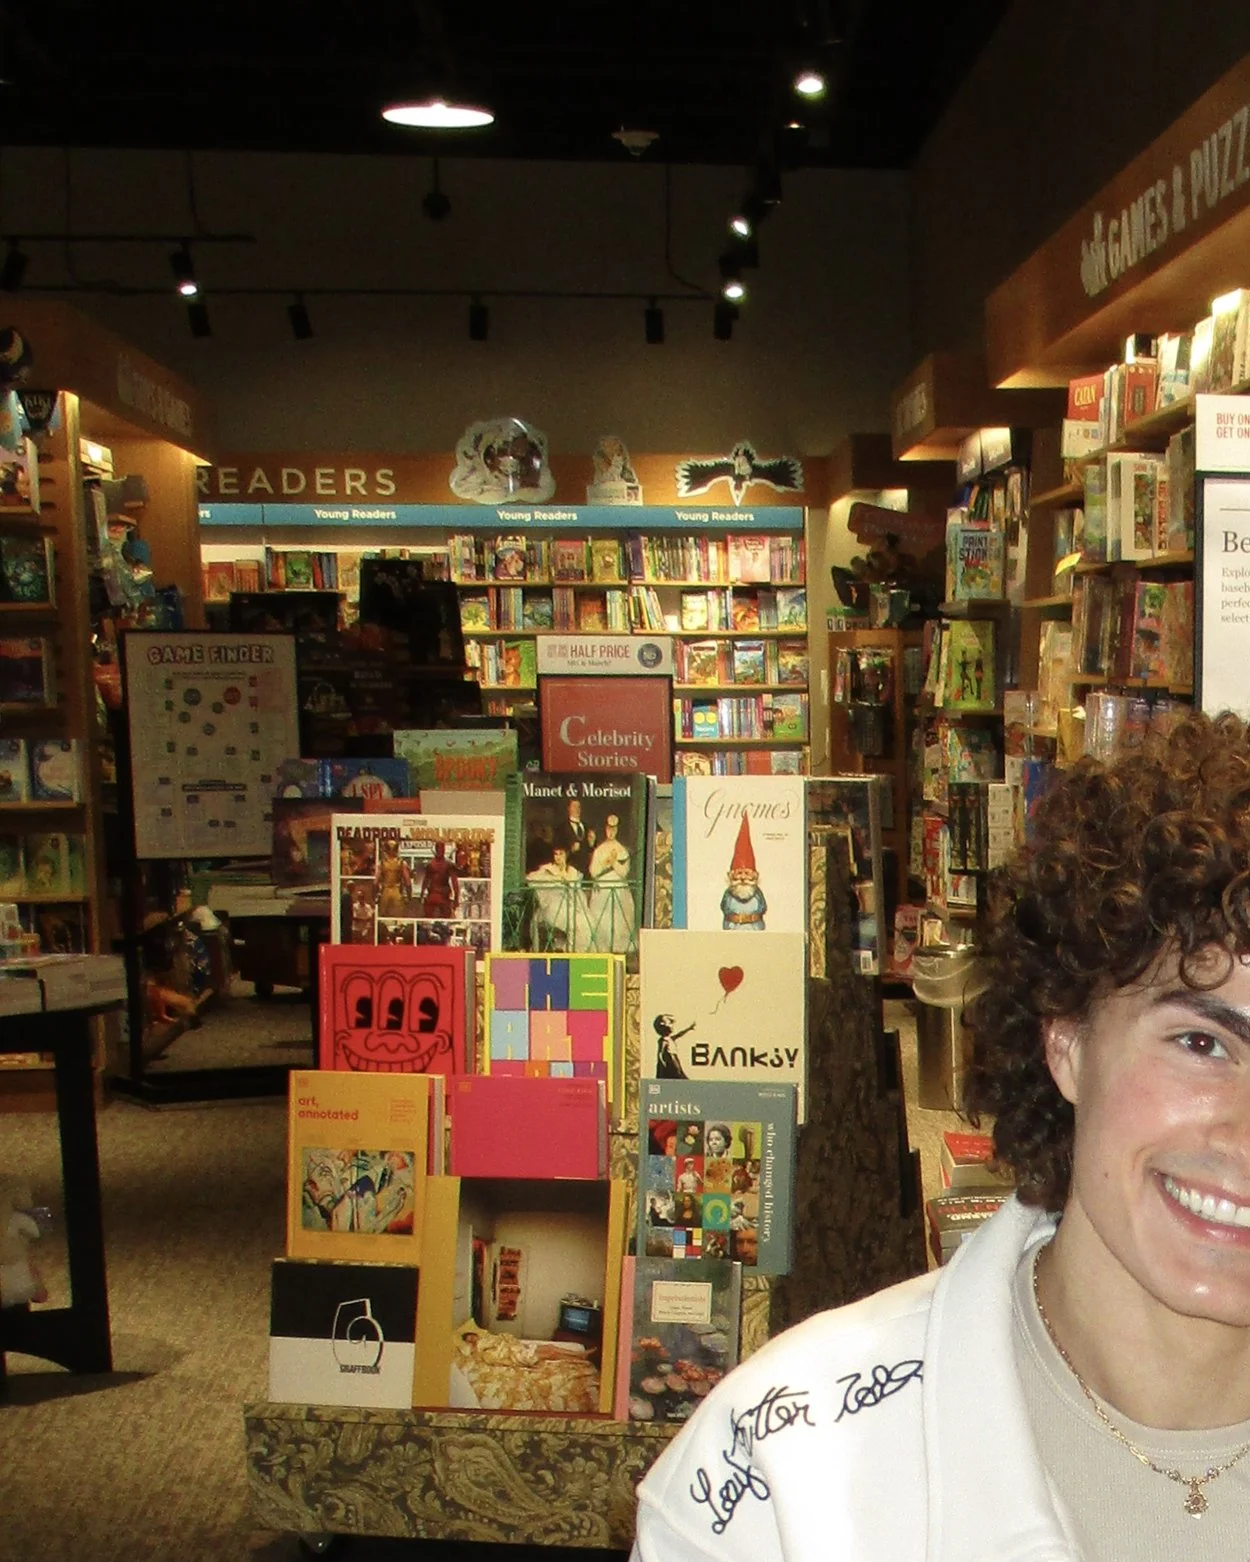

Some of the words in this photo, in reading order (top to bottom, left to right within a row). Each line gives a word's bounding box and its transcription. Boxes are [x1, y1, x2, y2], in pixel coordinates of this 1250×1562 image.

[1108, 179, 1168, 280] GAMES
[1217, 413, 1235, 425] BUY
[1217, 427, 1235, 438] GET
[194, 467, 397, 496] READERS
[313, 509, 349, 522] Young
[352, 509, 396, 520] Readers
[496, 510, 531, 522] Young
[534, 511, 577, 521] Readers
[676, 511, 709, 522] Young
[712, 512, 754, 522] Readers
[147, 645, 204, 665] GAME
[208, 645, 274, 664] FINDER
[571, 644, 595, 658] HALF
[600, 644, 630, 658] PRICE
[559, 715, 655, 750] Celebrity
[578, 752, 638, 767] Stories
[361, 783, 384, 800] SPY
[523, 783, 562, 798] Manet
[566, 783, 578, 798] &
[582, 782, 631, 798] Morisot
[337, 826, 401, 840] DEADPOOL
[491, 958, 608, 1010] THE
[691, 1043, 799, 1068] BANKSY
[298, 1095, 319, 1108] art,
[649, 1101, 701, 1115] artists
[298, 1109, 359, 1121] annotated
[767, 1122, 776, 1149] who
[764, 1151, 775, 1199] changed
